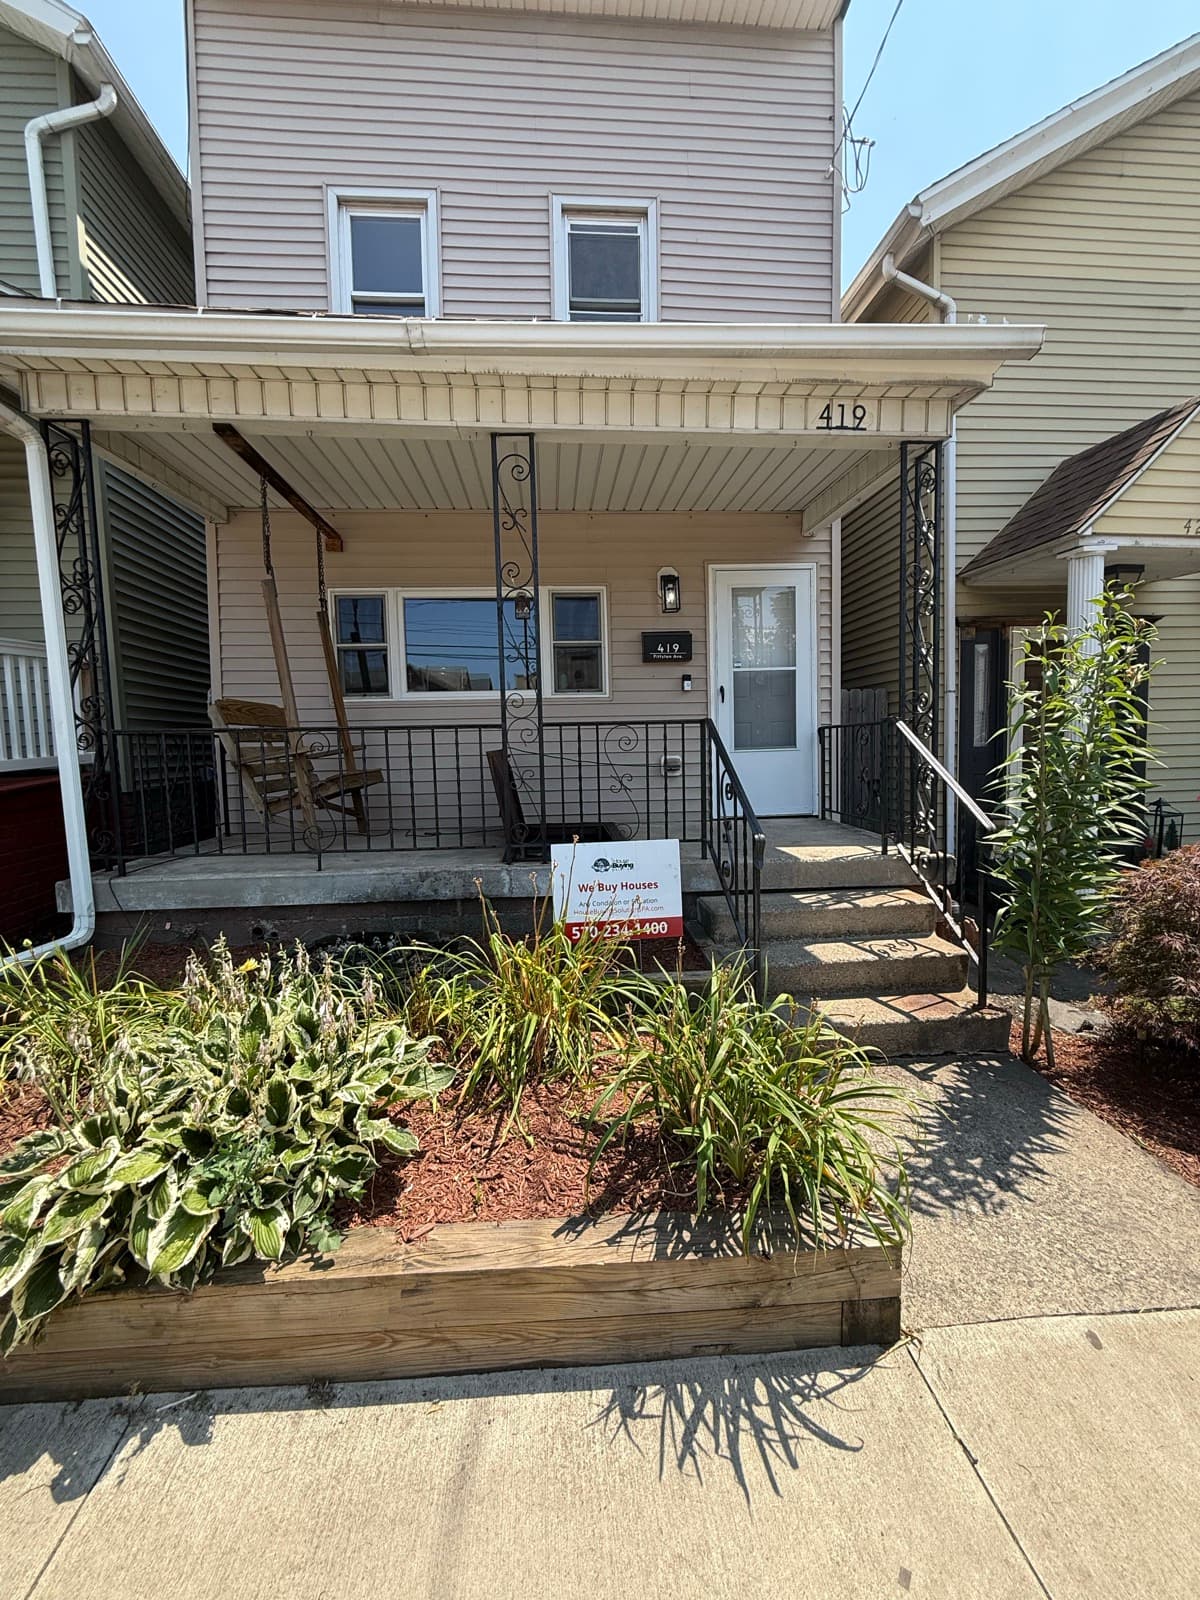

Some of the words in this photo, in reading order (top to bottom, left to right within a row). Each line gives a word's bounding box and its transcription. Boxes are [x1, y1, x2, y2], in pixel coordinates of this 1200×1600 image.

[818, 403, 867, 430] 419
[657, 643, 679, 653] 419
[612, 862, 634, 870] Buying
[578, 884, 595, 892] We
[597, 882, 618, 893] Buy
[620, 882, 659, 890] Houses
